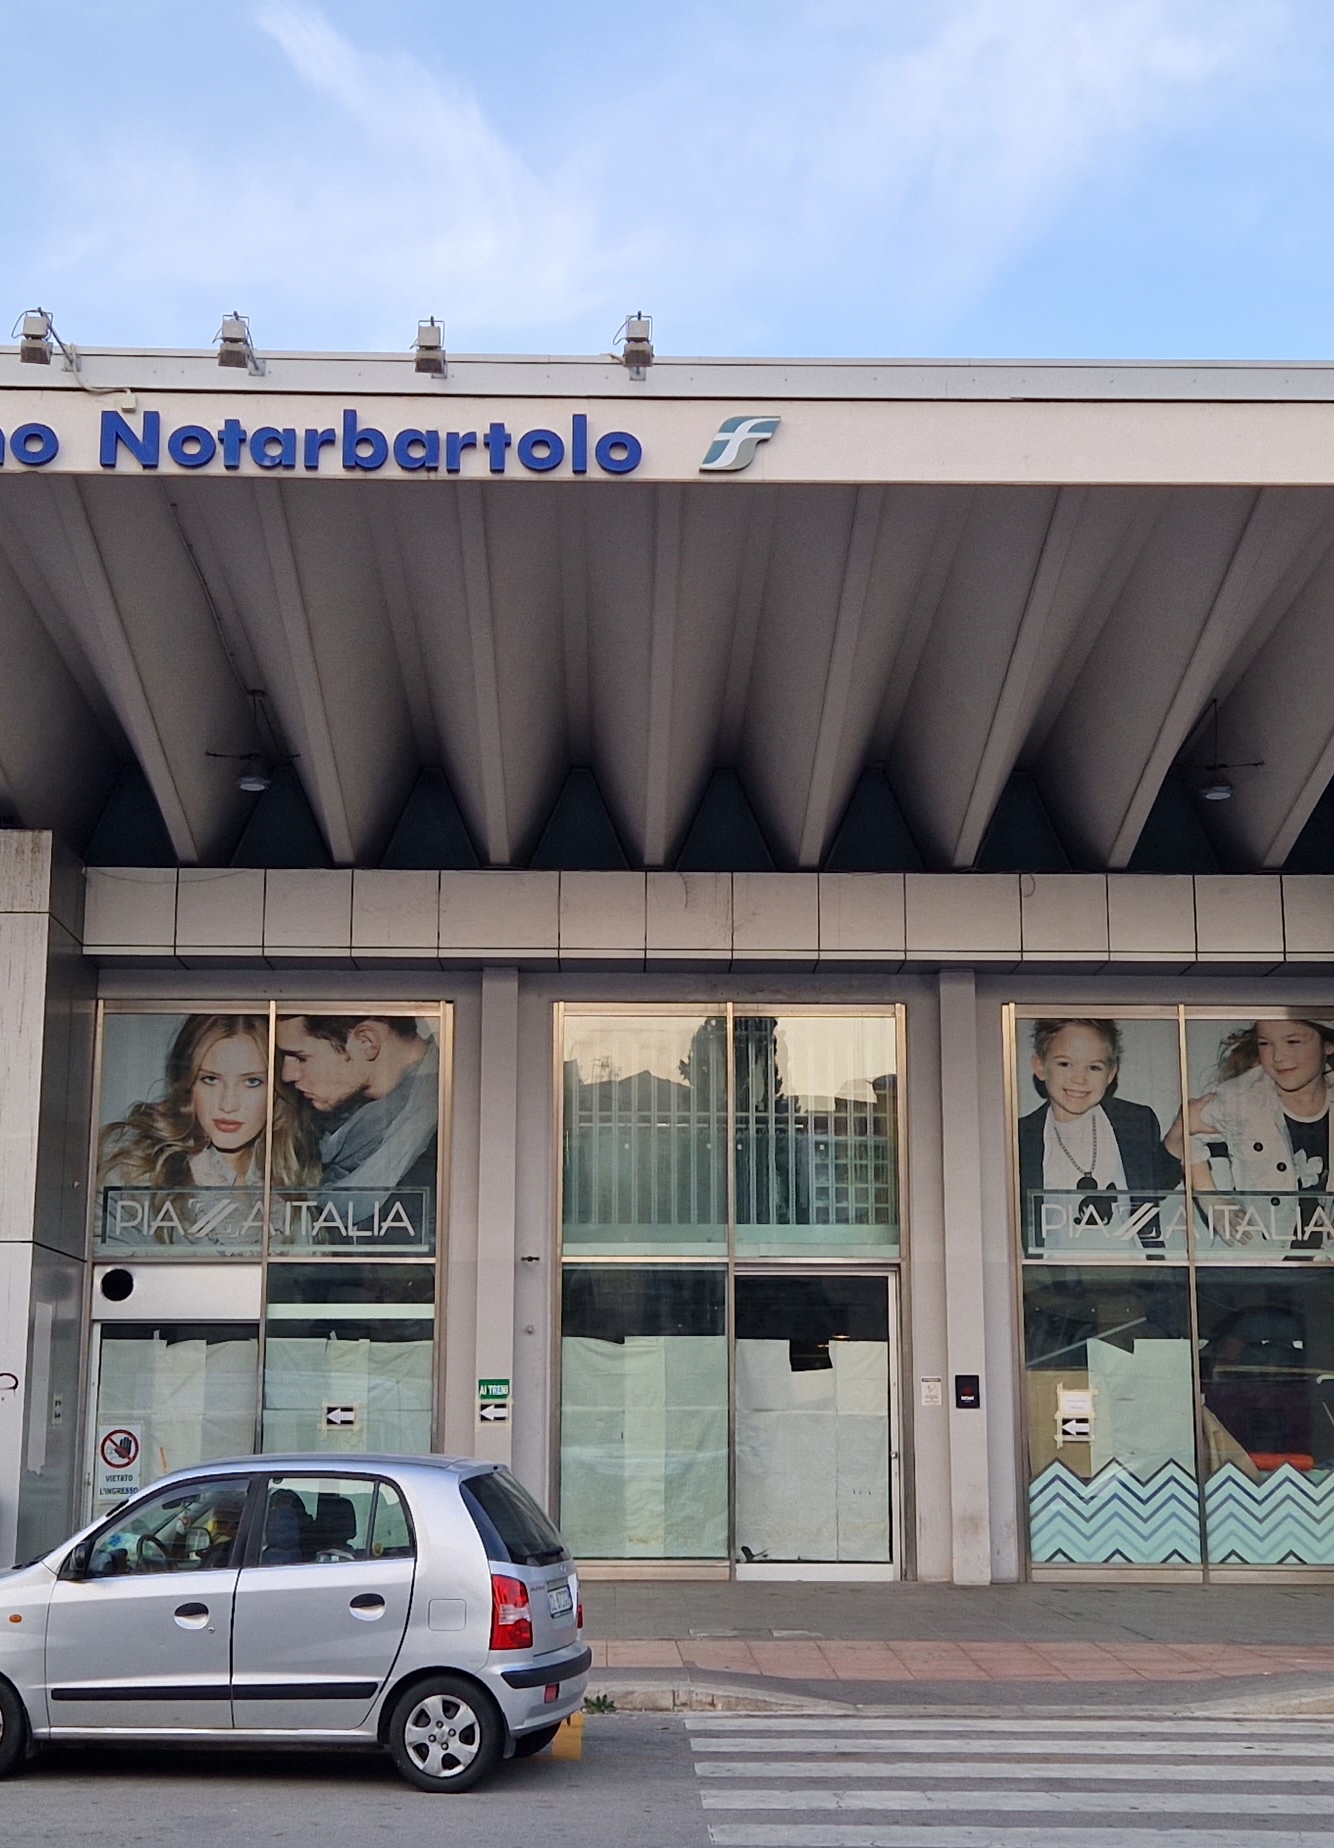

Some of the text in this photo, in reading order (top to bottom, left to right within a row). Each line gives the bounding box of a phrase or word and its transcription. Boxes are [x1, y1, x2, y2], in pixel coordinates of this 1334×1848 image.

[99, 409, 643, 474] Notarbartolo
[284, 1200, 415, 1237] ITALIA
[105, 1474, 134, 1483] VIETATO
